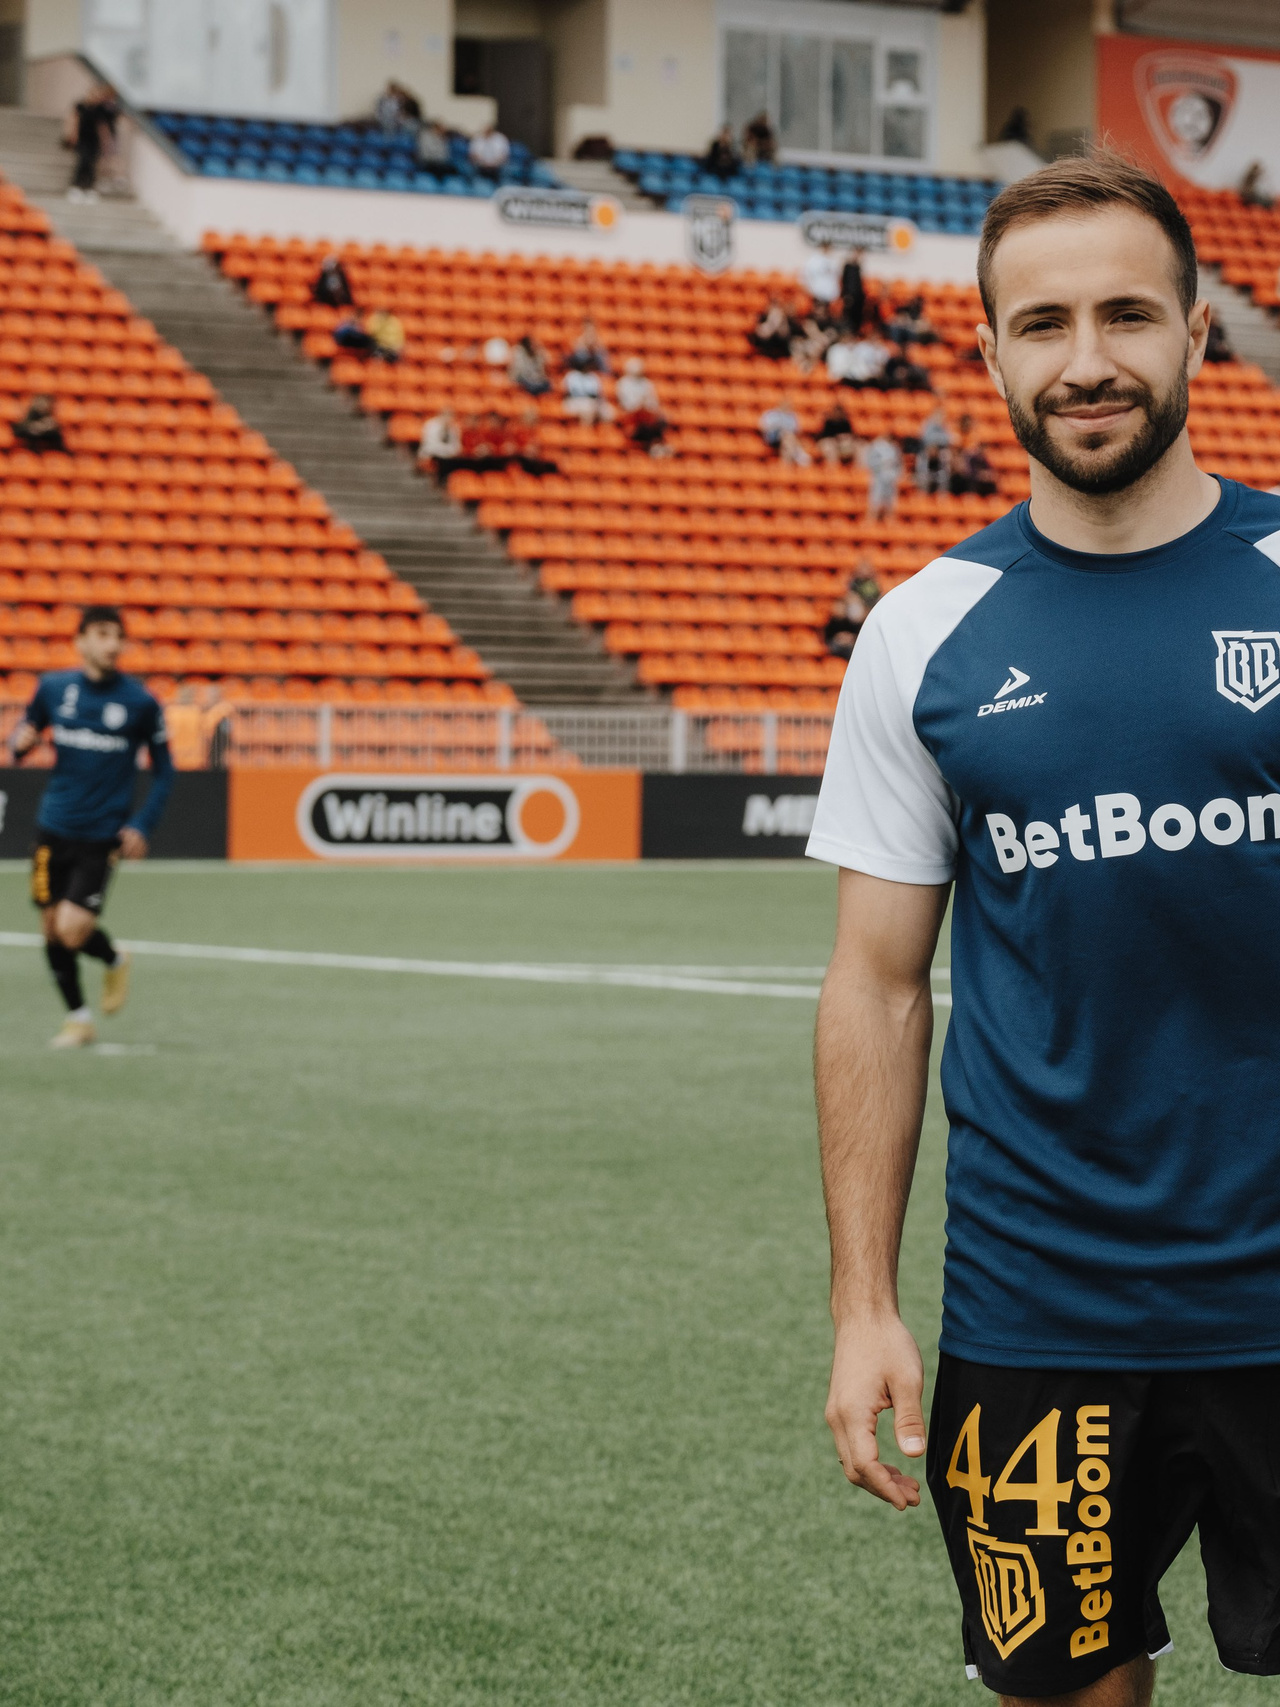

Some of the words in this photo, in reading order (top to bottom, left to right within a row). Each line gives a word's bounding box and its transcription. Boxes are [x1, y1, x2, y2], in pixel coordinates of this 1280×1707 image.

[977, 692, 1048, 717] DEMIX
[323, 792, 502, 841] Winline
[945, 1402, 1074, 1536] 44
[1066, 1404, 1113, 1659] BetBoom
